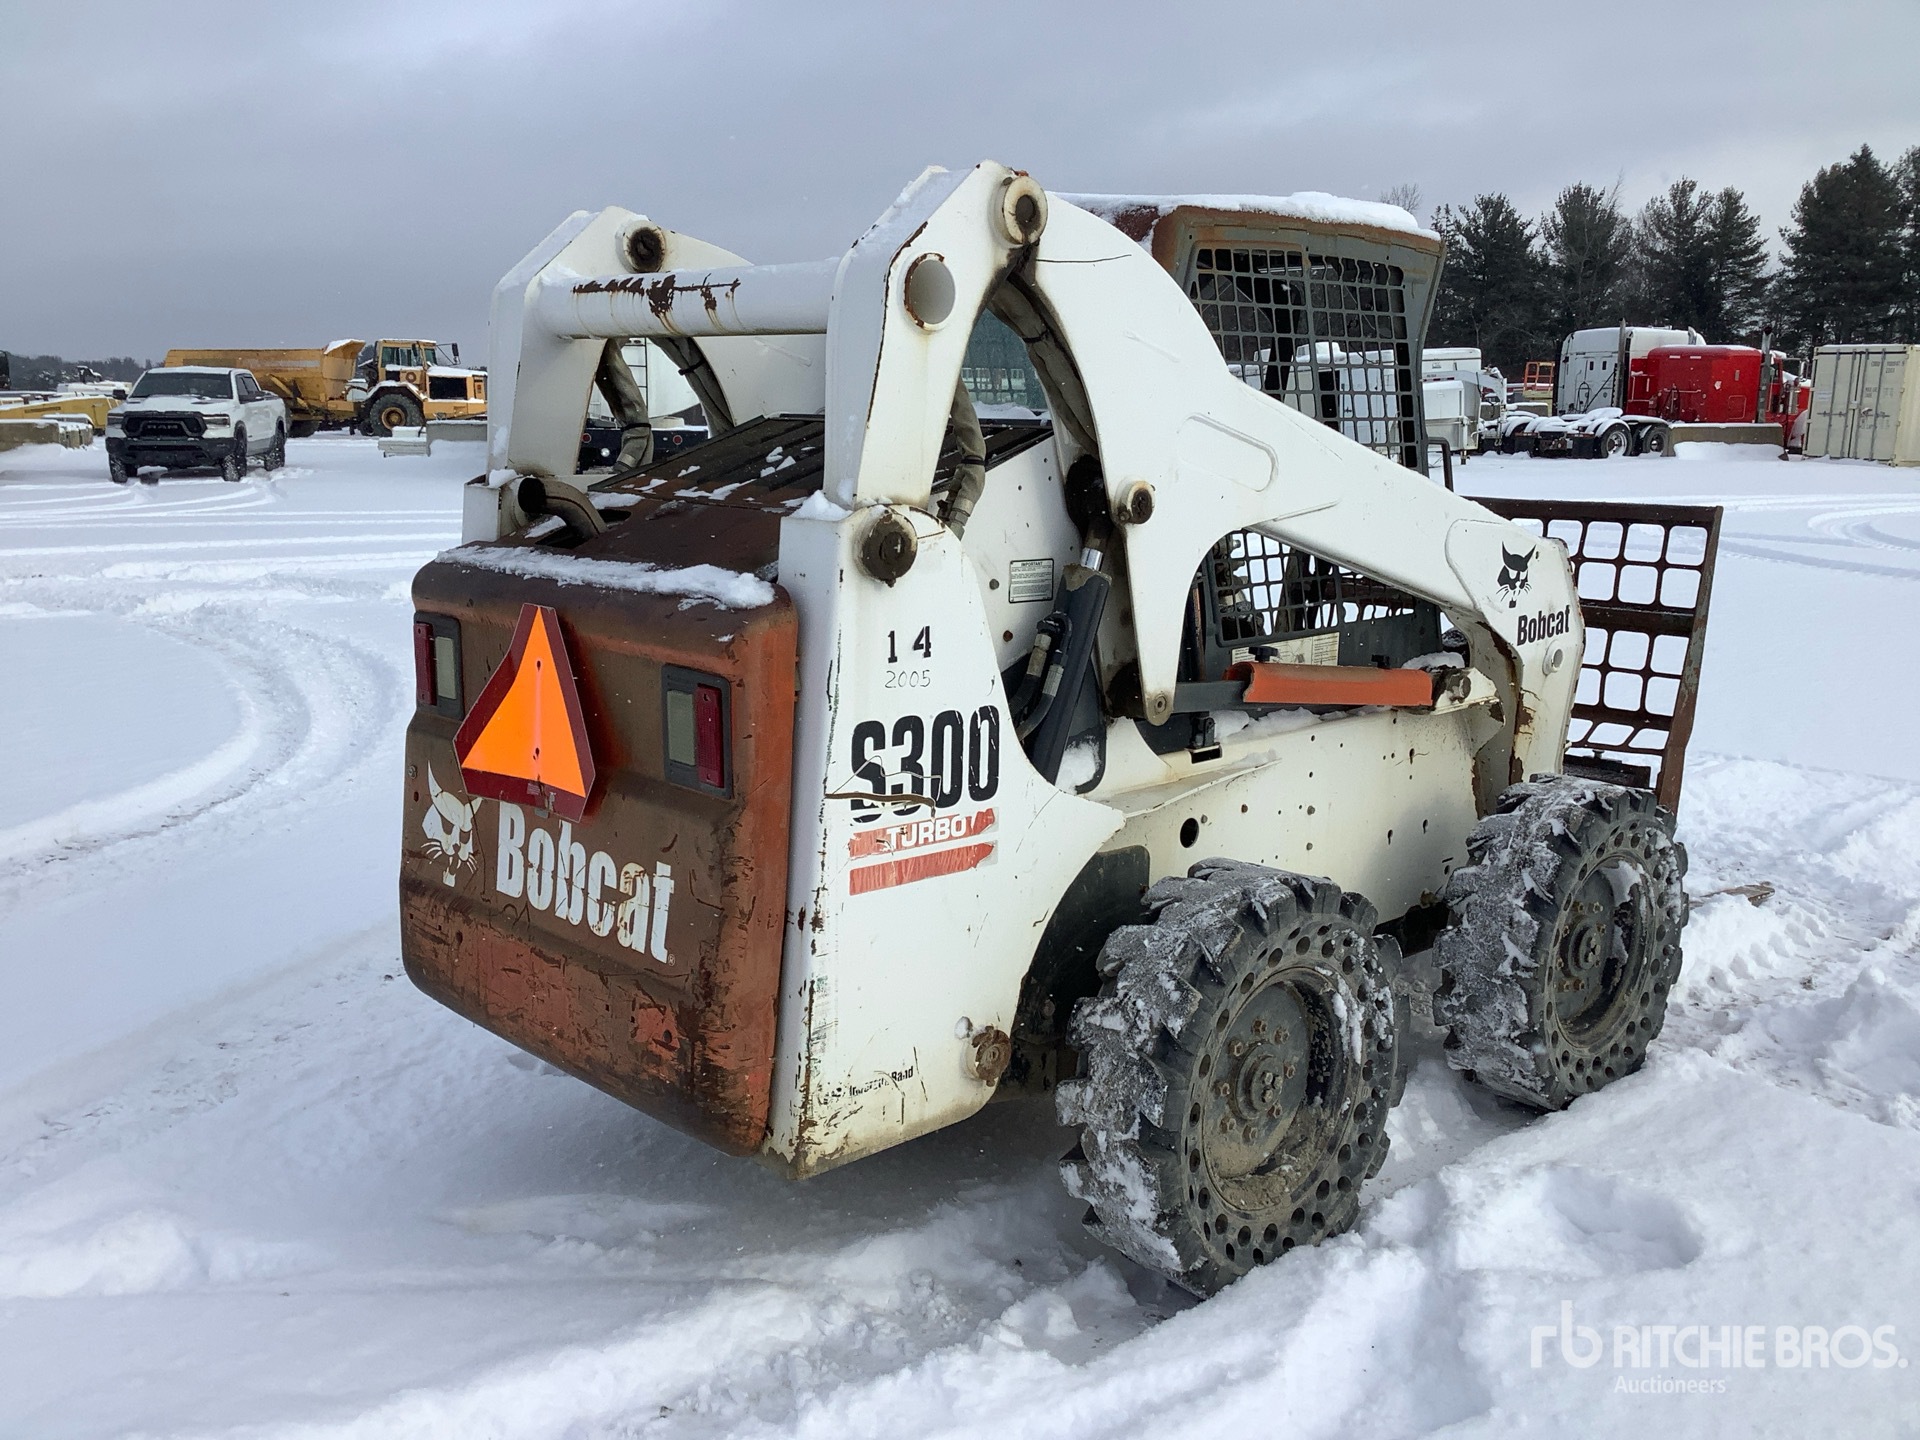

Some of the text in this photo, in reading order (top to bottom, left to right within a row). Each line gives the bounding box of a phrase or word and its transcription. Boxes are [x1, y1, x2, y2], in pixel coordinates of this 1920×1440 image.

[1517, 604, 1570, 646] Bobcat
[884, 669, 931, 689] 2005
[850, 705, 1000, 823] S300
[886, 816, 967, 850] TURBO
[496, 801, 675, 964] Bobcat
